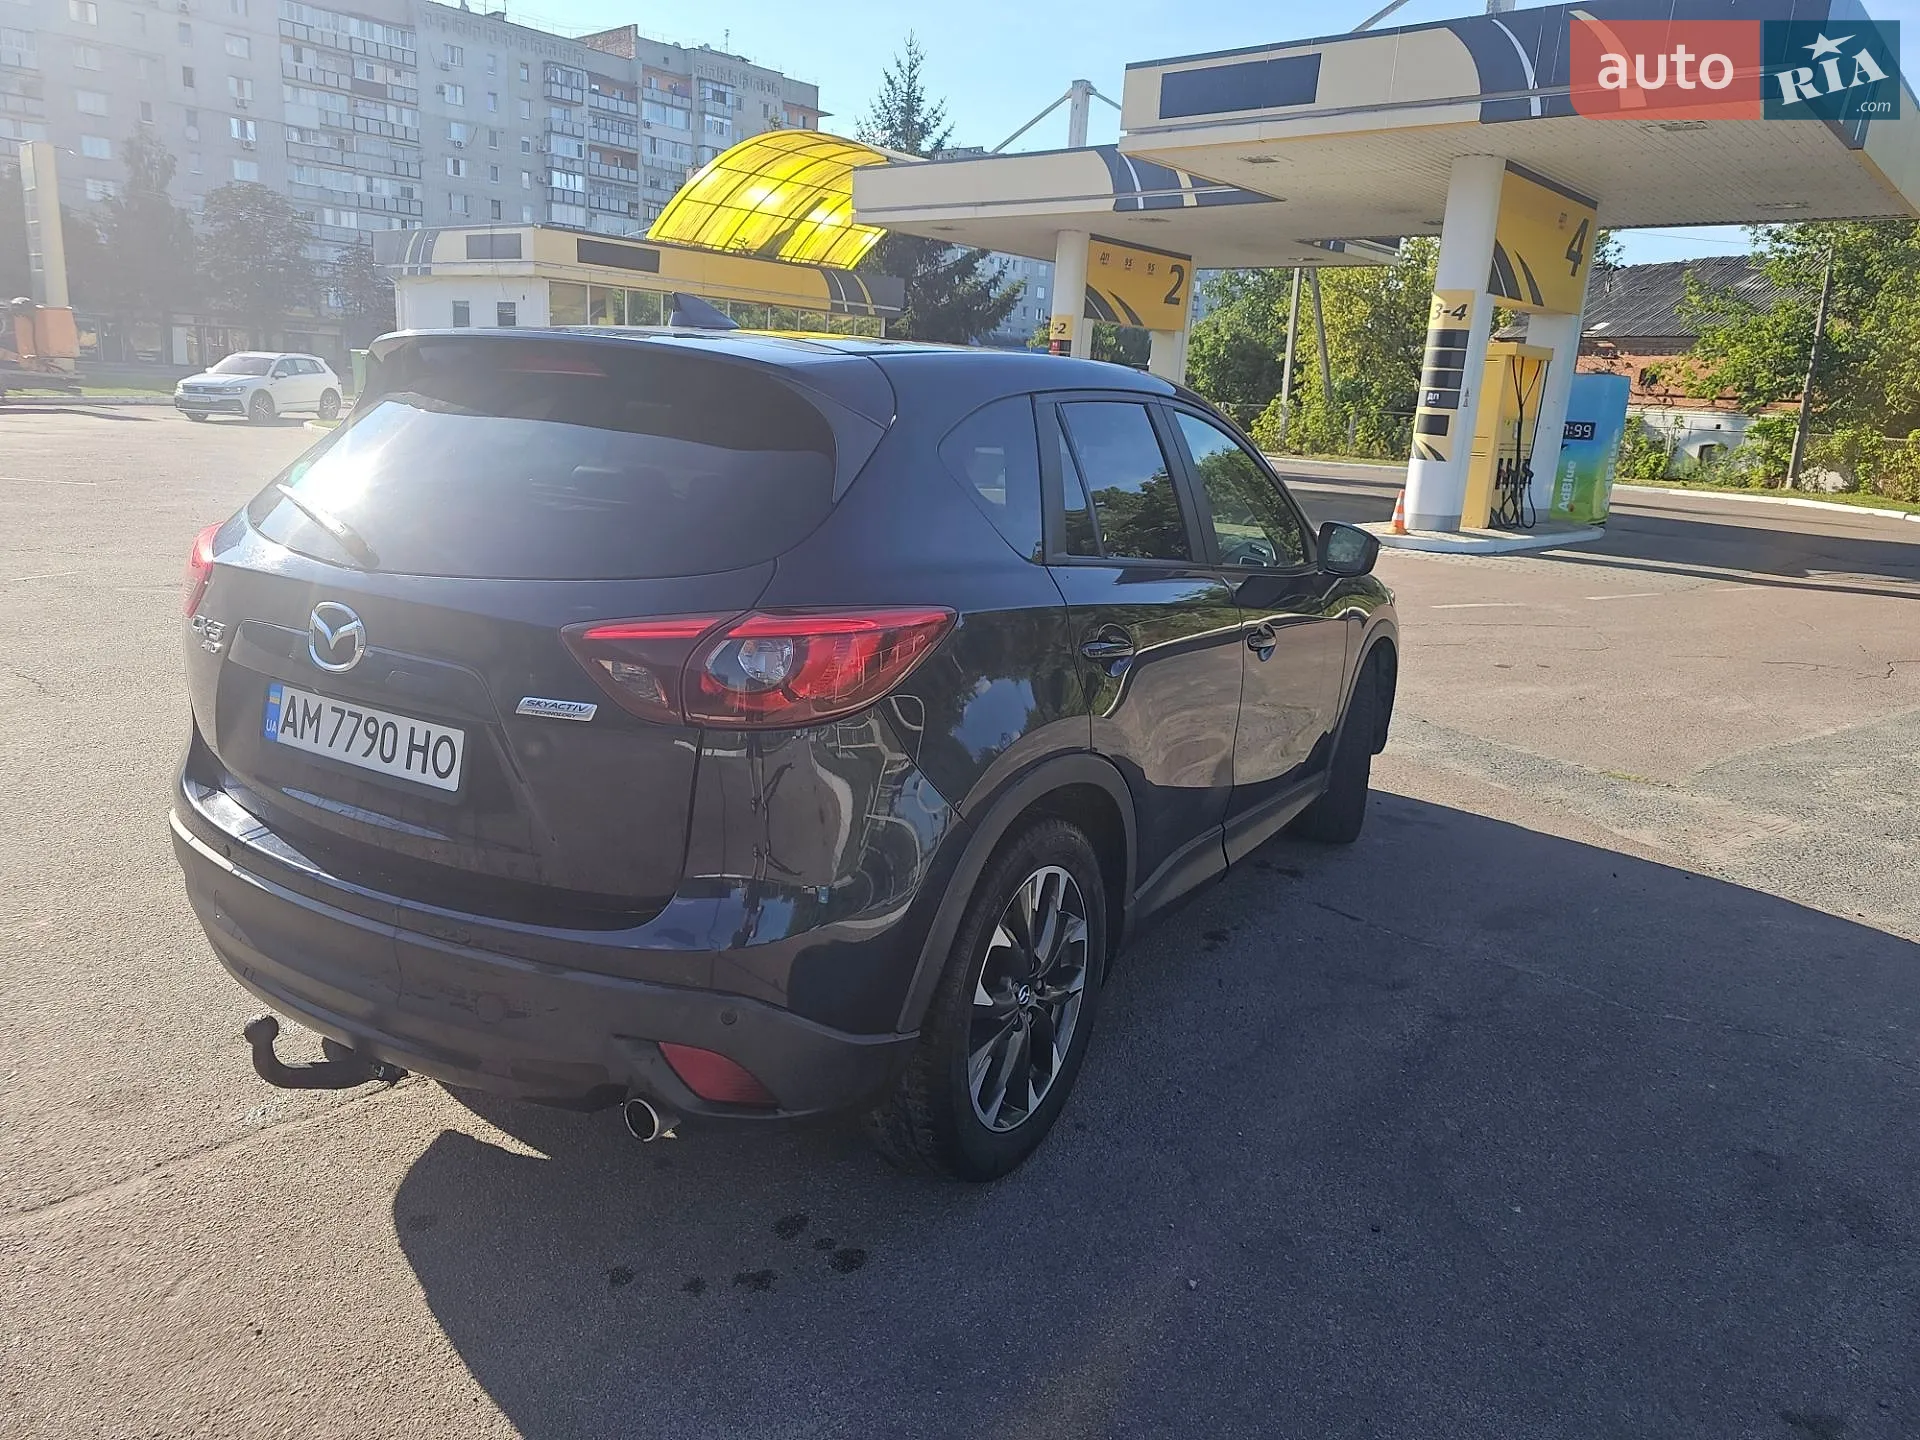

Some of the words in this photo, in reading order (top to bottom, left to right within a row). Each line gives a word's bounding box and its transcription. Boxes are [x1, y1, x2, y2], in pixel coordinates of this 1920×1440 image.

[1564, 217, 1590, 278] 4
[1163, 264, 1185, 306] 2
[1431, 303, 1468, 321] 3-4
[1558, 460, 1576, 512] AdBlue
[525, 699, 591, 712] SKYACTIV
[530, 709, 577, 719] TECHNOLOGY
[265, 718, 277, 733] UA
[279, 695, 323, 744] AM
[327, 706, 399, 764] 7790
[405, 726, 457, 780] HO
